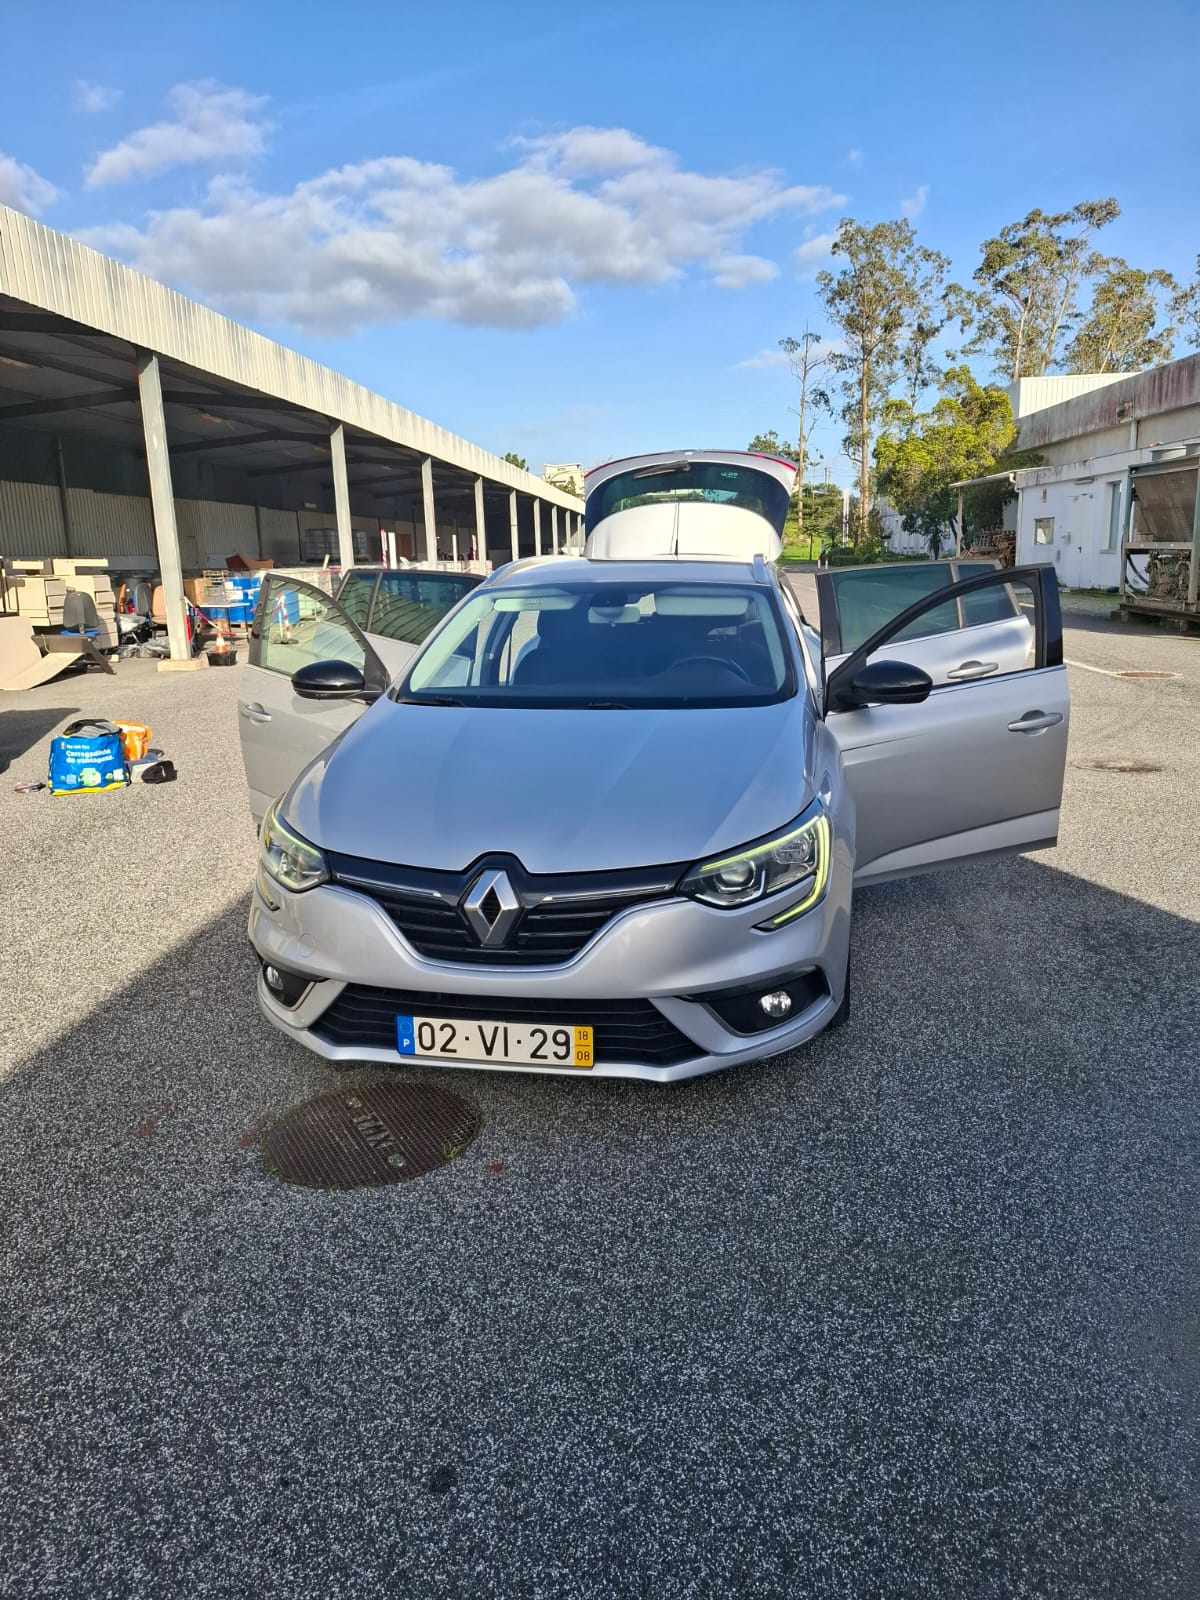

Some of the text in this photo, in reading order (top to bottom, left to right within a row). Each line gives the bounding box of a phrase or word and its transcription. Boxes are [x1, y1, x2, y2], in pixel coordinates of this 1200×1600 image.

[578, 1030, 589, 1041] 18
[403, 1038, 410, 1048] P
[577, 1051, 590, 1061] 08
